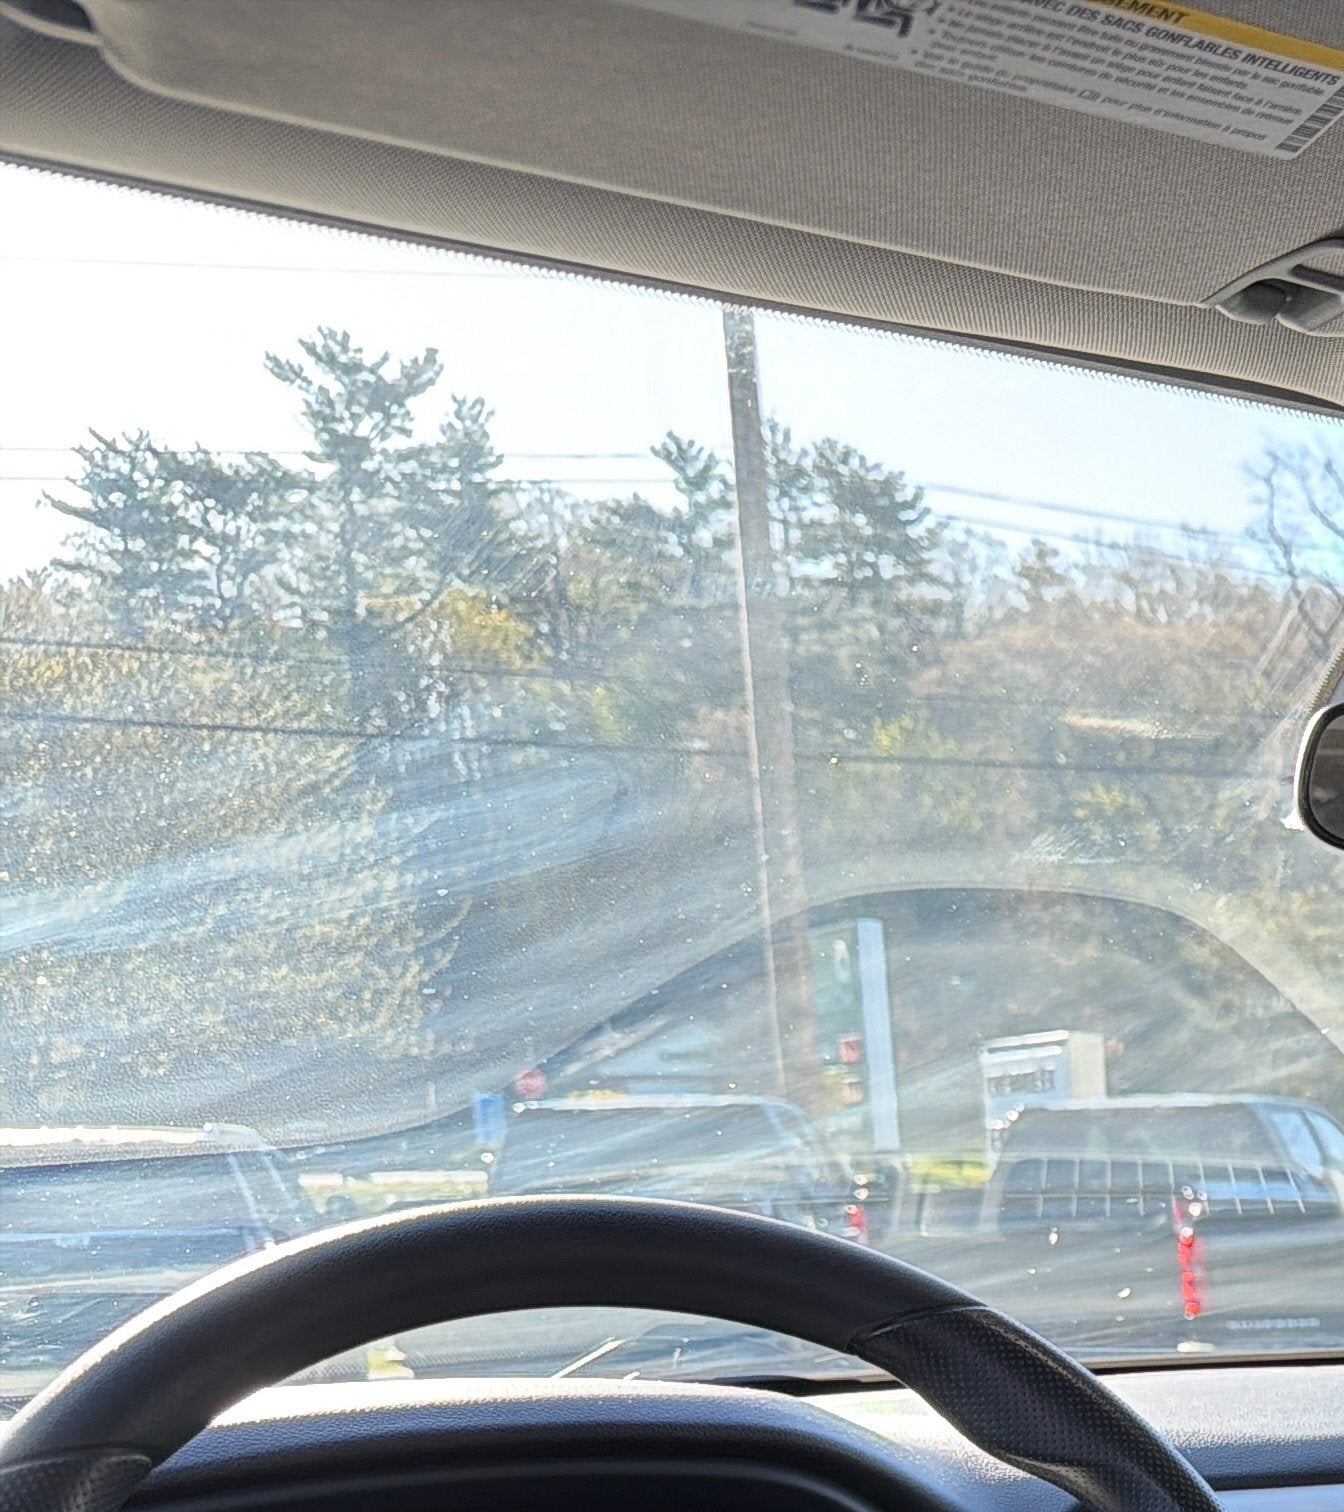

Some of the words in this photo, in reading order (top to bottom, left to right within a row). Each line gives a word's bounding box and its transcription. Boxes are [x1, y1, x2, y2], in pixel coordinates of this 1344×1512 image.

[1066, 5, 1101, 20] DES
[1100, 14, 1145, 33] SACS
[1145, 26, 1242, 60] GONFLABLES
[1241, 52, 1341, 85] INTELLIGENTS
